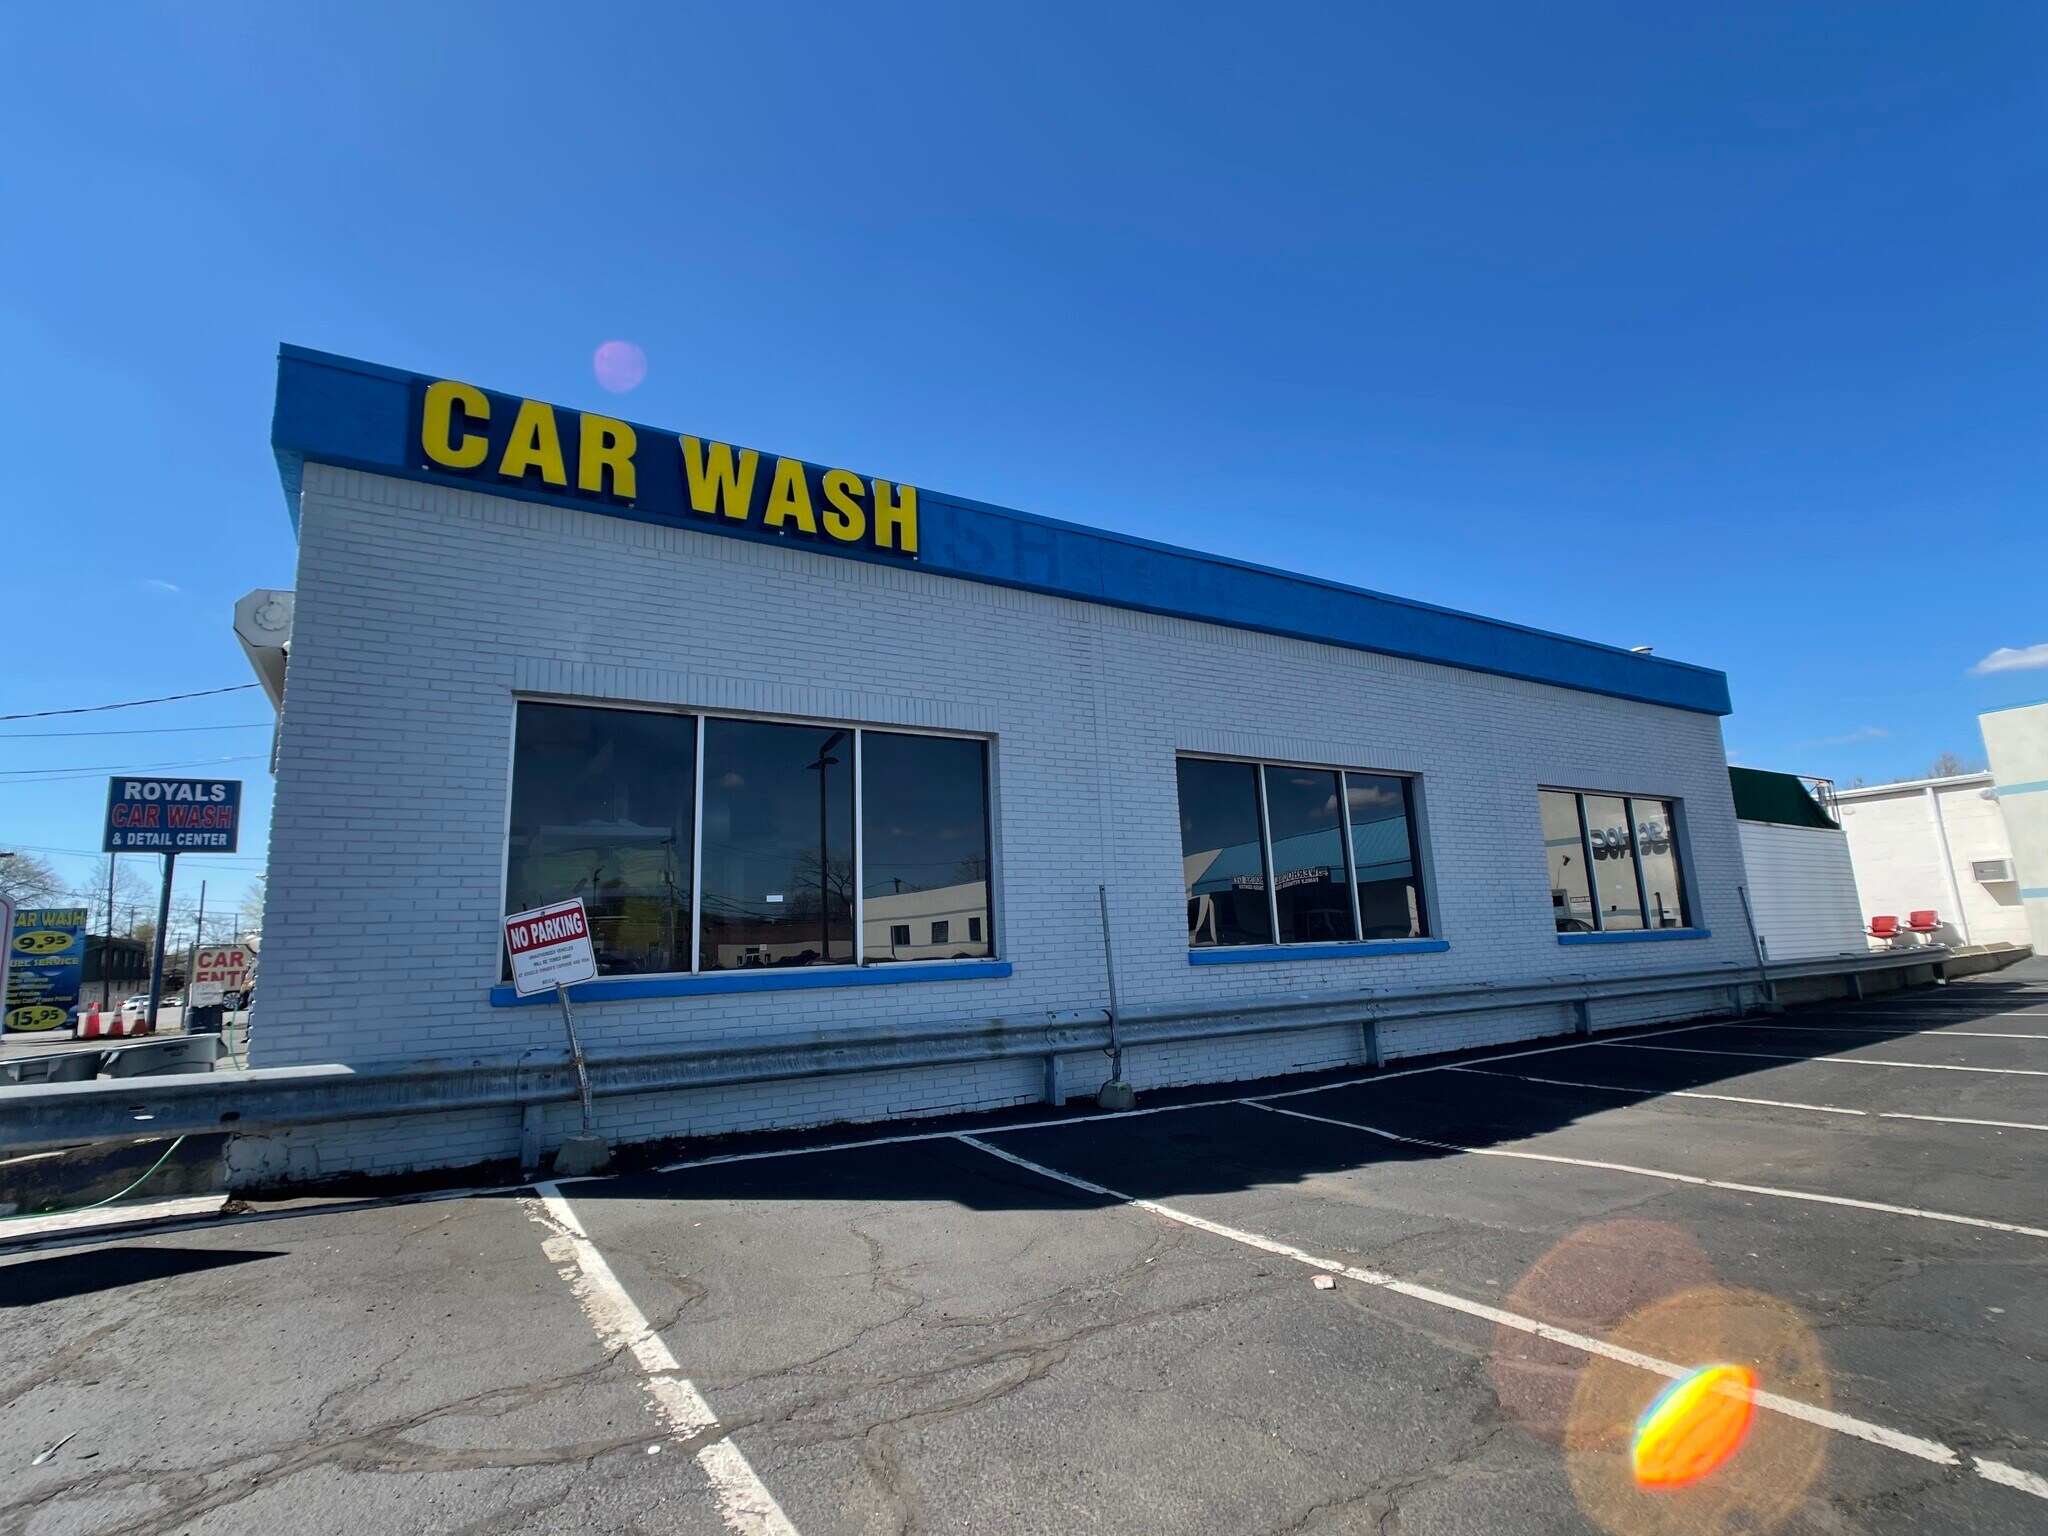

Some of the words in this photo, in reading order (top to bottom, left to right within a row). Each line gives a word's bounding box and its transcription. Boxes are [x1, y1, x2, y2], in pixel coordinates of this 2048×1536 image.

[421, 380, 637, 498] CAR
[678, 434, 919, 554] WASH
[124, 782, 226, 802] ROYALS
[112, 803, 160, 828] CAR
[168, 805, 232, 829] WASH
[112, 832, 122, 845] &
[126, 833, 172, 845] DETAIL
[176, 833, 227, 846] CENTER
[15, 911, 38, 927] AR
[41, 911, 87, 926] WASH
[510, 926, 529, 949] NO
[530, 912, 584, 945] PARKING
[18, 935, 67, 950] 9.95
[33, 957, 79, 966] SERVICE
[197, 951, 245, 969] CAR
[11, 1009, 59, 1027] 15.95
